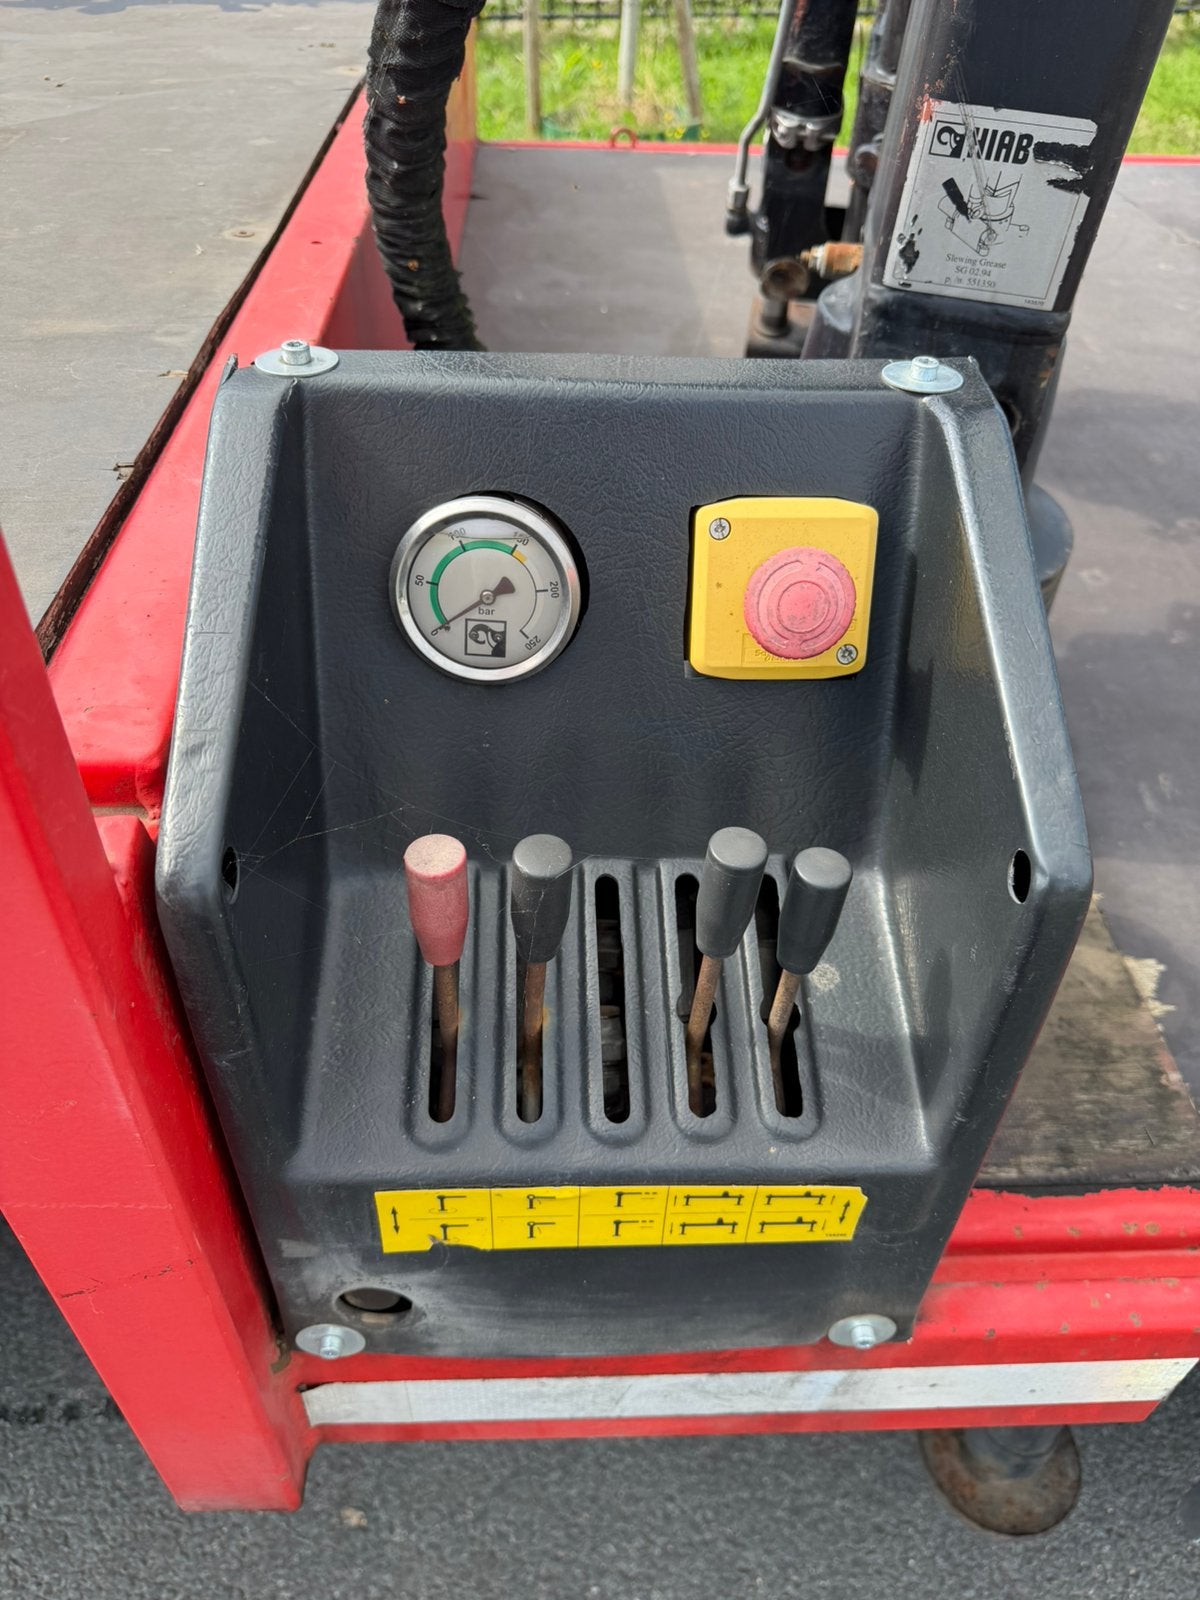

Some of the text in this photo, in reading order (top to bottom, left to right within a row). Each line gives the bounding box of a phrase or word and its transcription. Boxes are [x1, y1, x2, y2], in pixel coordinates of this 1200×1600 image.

[967, 127, 1034, 165] HIAB
[945, 253, 1007, 269] Slewing Grease
[954, 265, 968, 275] SG
[414, 574, 425, 587] 50
[549, 581, 559, 599] 200
[478, 606, 495, 616] bar
[524, 634, 542, 652] 250
